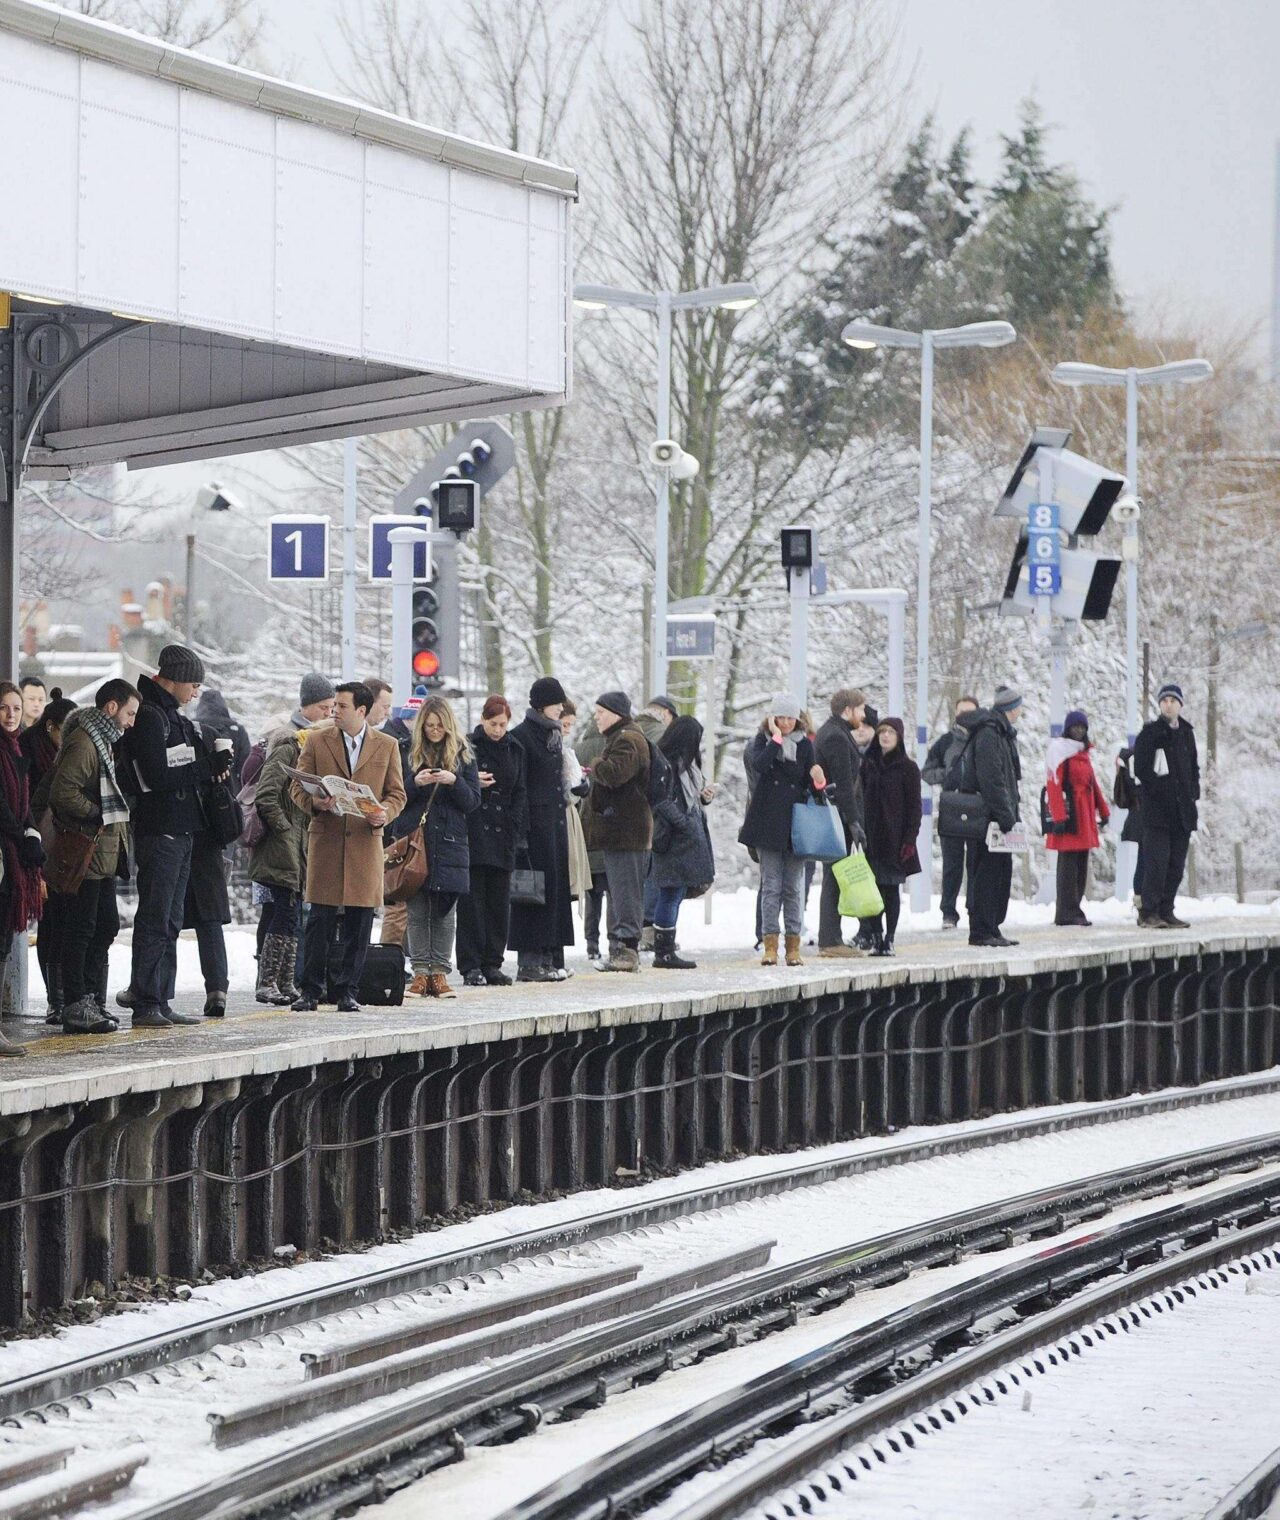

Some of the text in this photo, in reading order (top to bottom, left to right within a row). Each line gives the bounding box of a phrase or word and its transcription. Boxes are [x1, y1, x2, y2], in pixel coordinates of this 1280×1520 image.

[1035, 505, 1052, 528] 8
[284, 530, 302, 571] 1
[1036, 535, 1053, 558] 6
[1036, 566, 1052, 588] 5
